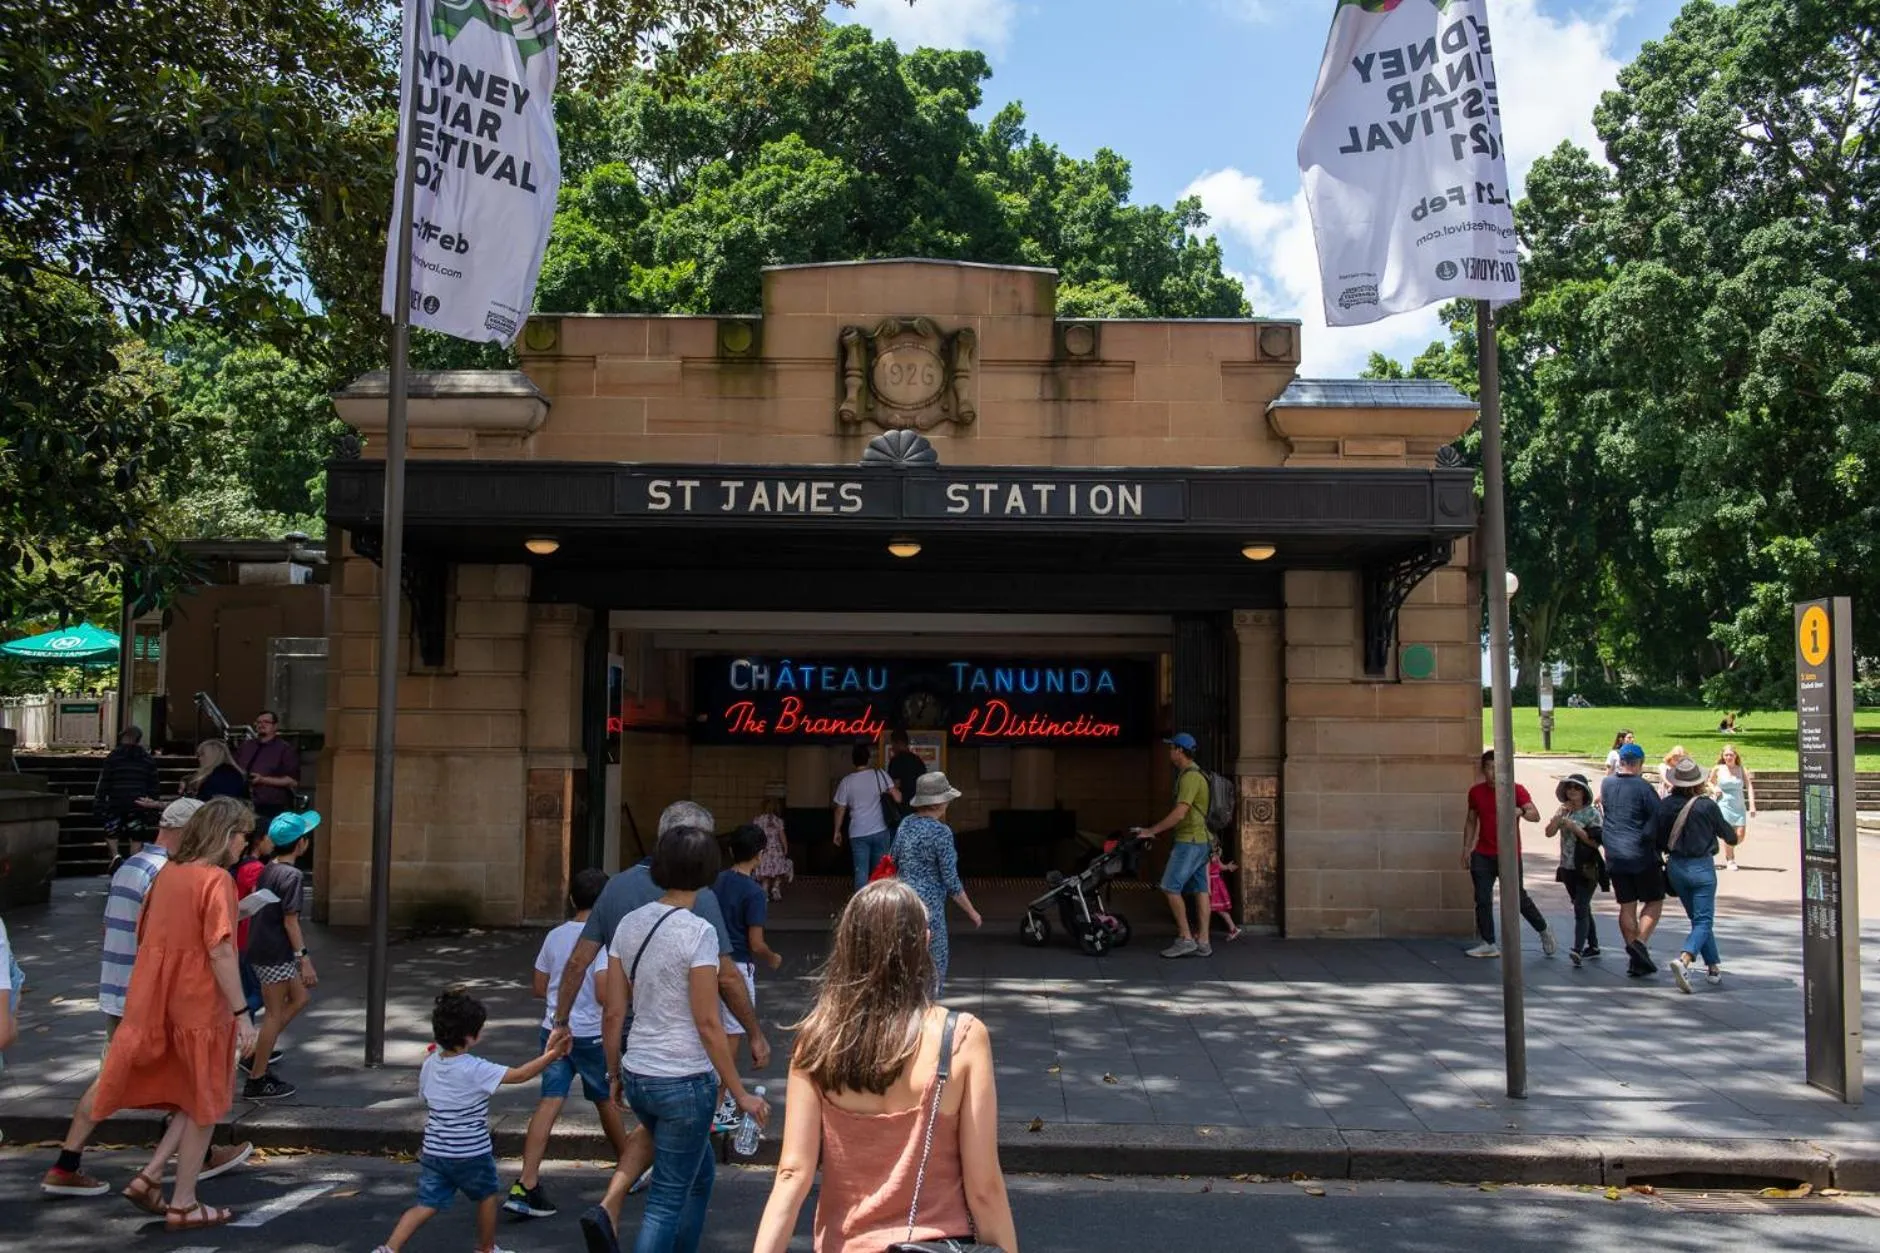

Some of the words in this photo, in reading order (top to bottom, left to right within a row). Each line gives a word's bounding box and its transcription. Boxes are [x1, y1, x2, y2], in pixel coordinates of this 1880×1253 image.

[882, 362, 935, 387] 1926
[648, 480, 700, 511] ST
[720, 480, 863, 512] JAMES
[946, 483, 1142, 515] STATION
[730, 659, 888, 691] CHÂTEAU
[949, 662, 1116, 693] TANUNDA
[725, 701, 768, 733] The
[775, 696, 886, 743] Brandy
[952, 708, 980, 743] of
[976, 699, 1121, 738] Distinction
